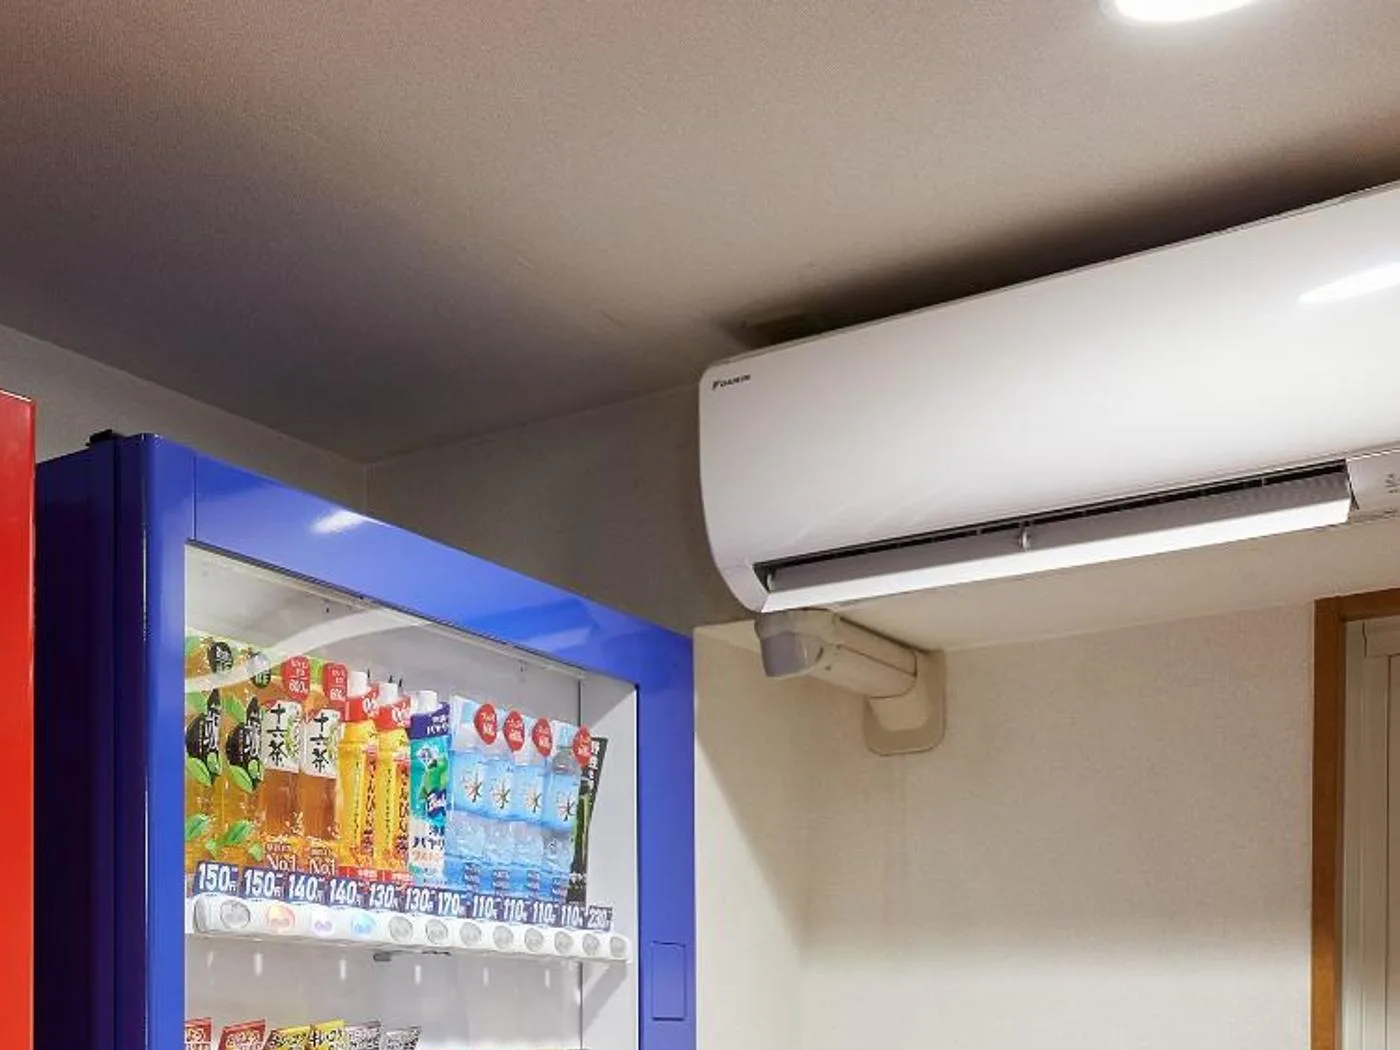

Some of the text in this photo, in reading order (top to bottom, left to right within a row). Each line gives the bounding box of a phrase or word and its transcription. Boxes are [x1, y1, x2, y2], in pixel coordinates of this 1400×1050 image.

[267, 703, 289, 767] 十六茶
[310, 713, 331, 773] 十六茶
